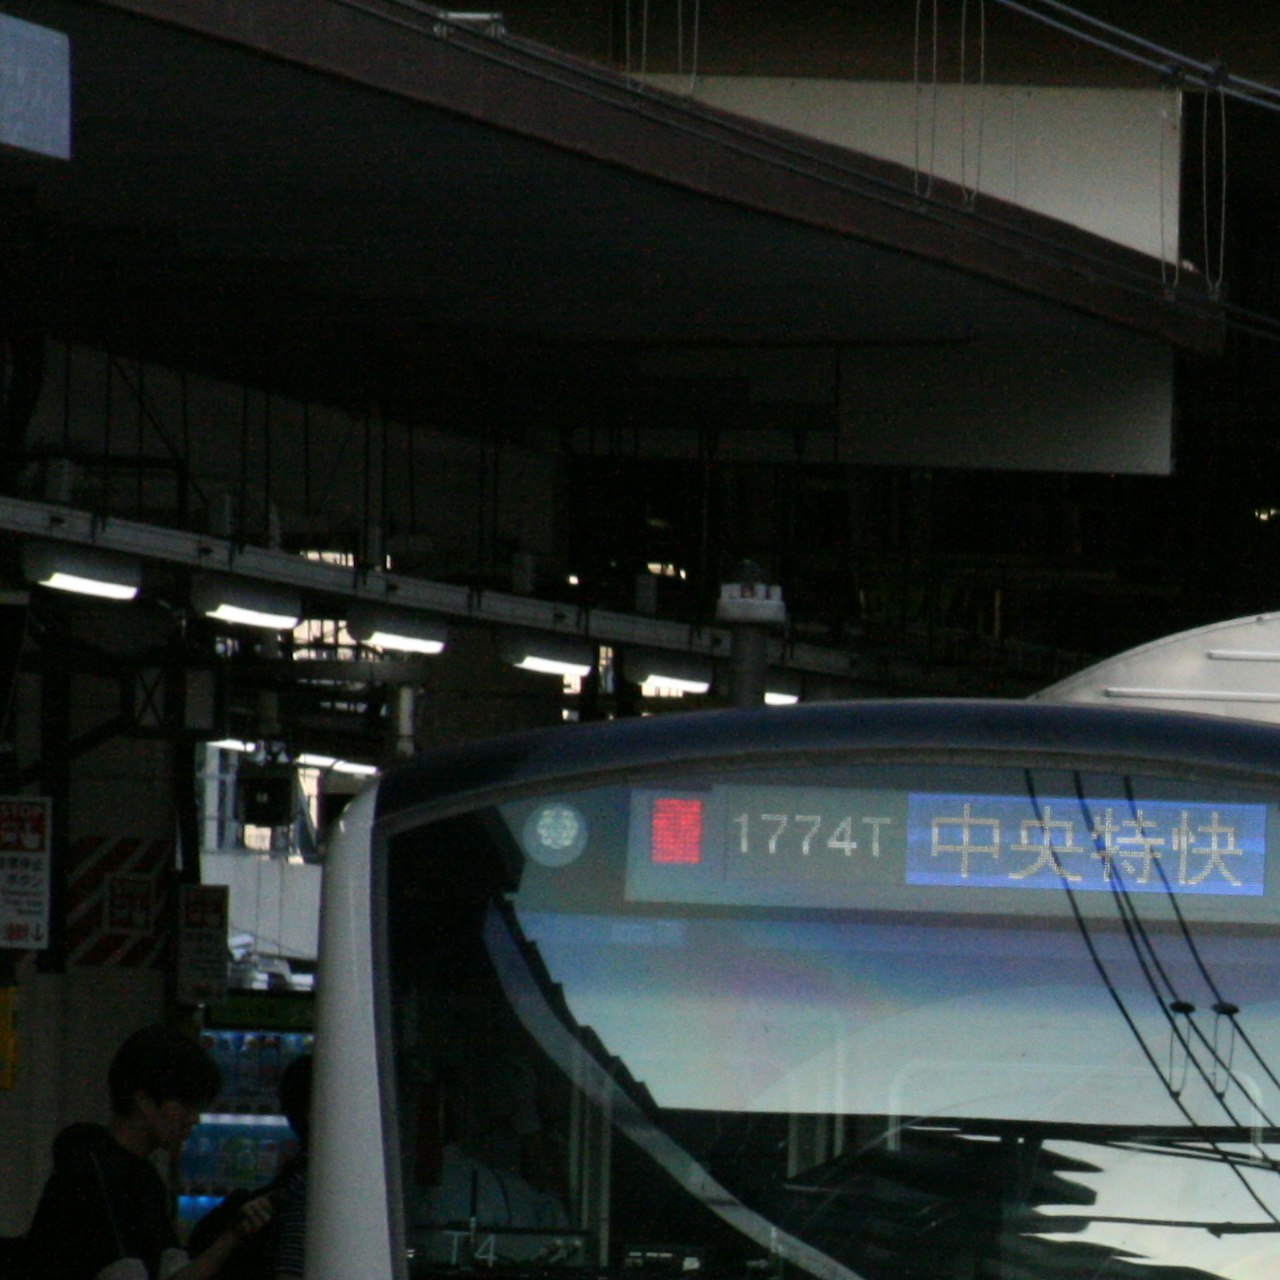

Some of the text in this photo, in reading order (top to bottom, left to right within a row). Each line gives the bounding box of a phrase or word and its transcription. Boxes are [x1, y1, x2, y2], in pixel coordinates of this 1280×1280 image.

[732, 813, 891, 857] 1774T
[930, 802, 1243, 886] 中央特快
